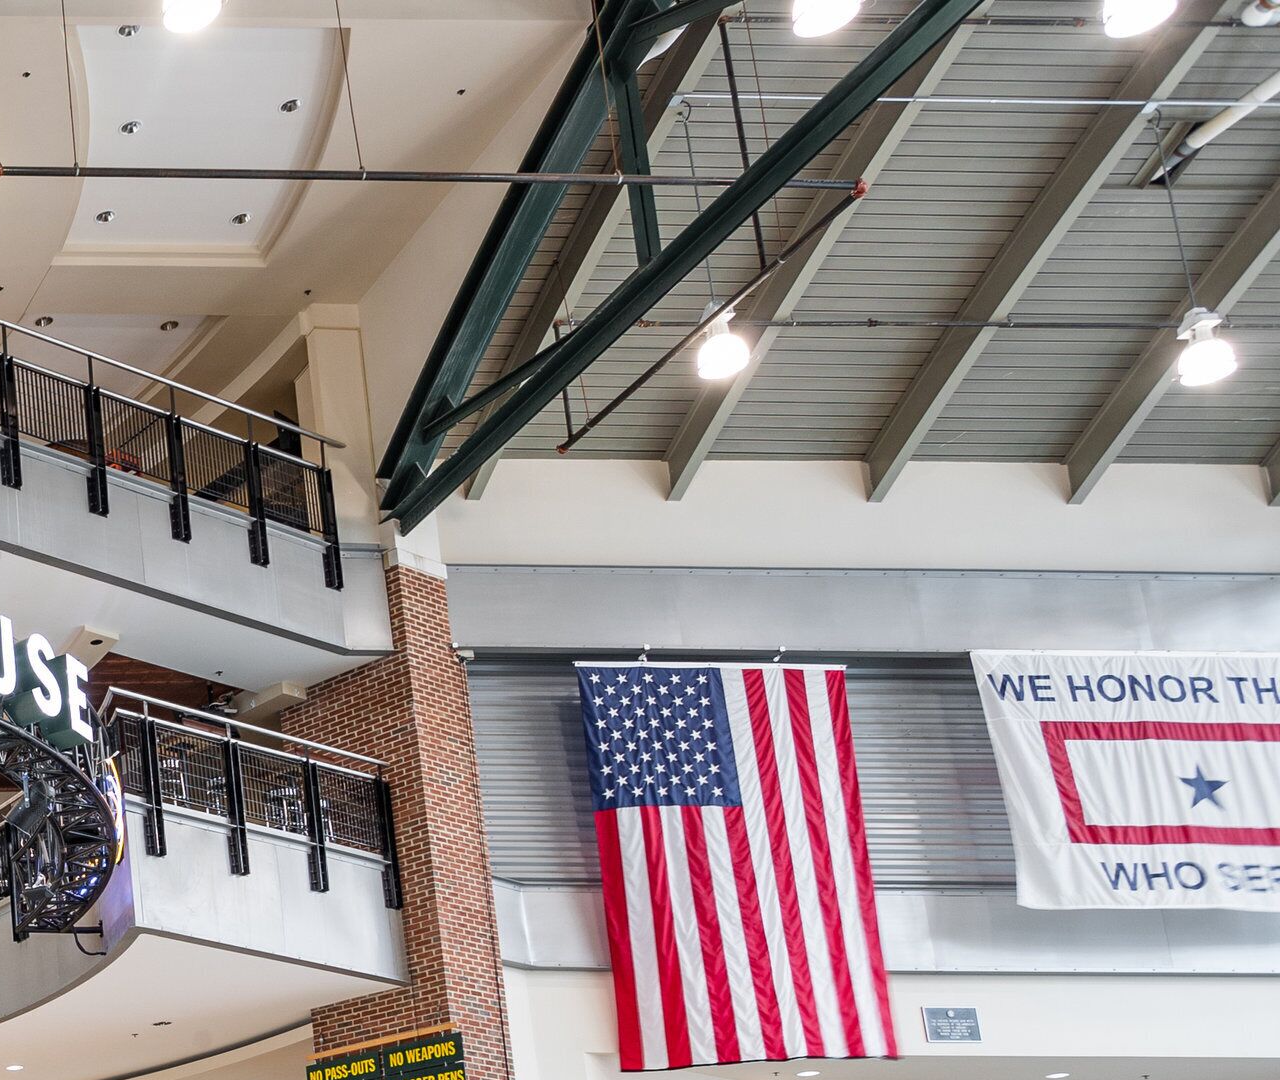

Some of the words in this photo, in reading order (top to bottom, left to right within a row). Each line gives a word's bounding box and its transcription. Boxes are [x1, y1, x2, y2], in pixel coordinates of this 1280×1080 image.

[986, 674, 1055, 702] WE
[1066, 674, 1219, 704] HONOR
[1100, 861, 1208, 891] WHO
[389, 1053, 404, 1067] NO
[405, 1041, 456, 1064] WEAPONS
